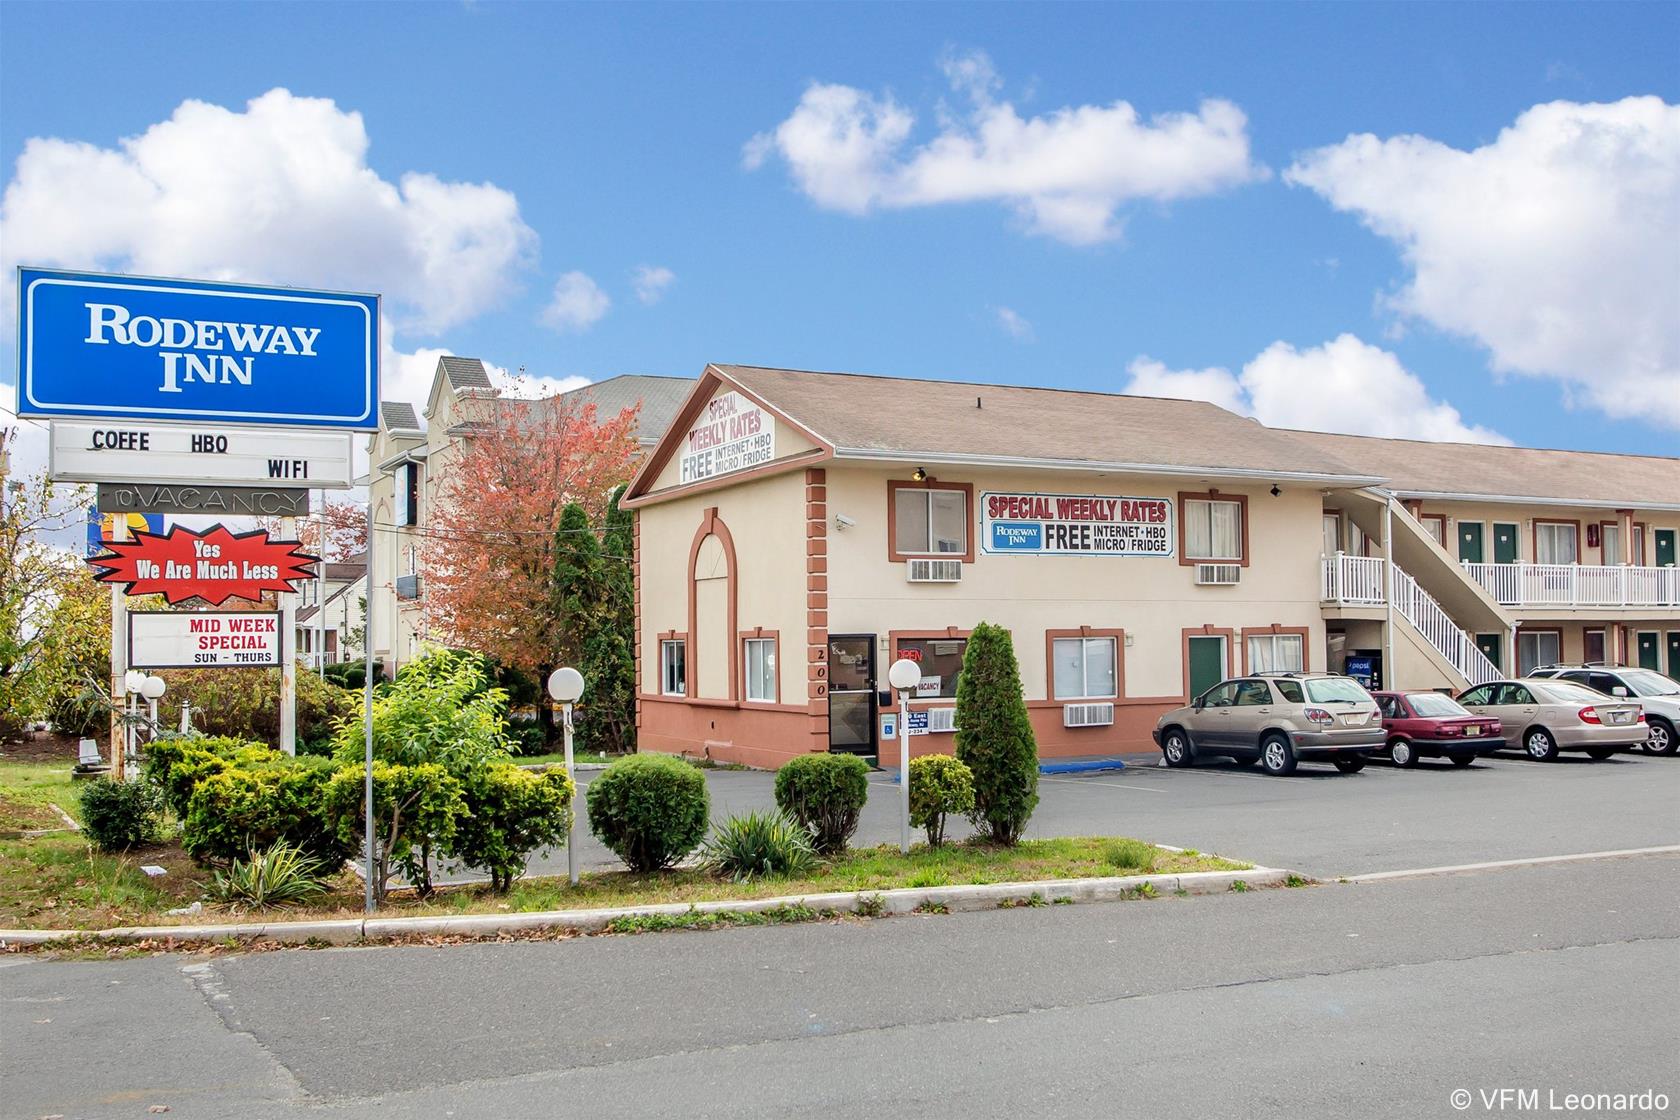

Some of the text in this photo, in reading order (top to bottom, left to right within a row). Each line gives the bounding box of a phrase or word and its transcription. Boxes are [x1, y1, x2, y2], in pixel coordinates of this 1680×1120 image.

[85, 302, 321, 356] RODEWAY
[159, 351, 254, 393] INN
[709, 394, 738, 422] SPECIAL
[689, 408, 761, 452] WEEKLY RATES
[93, 431, 228, 453] COFFE HBO
[268, 459, 308, 478] WIFI
[683, 451, 712, 482] FREE
[135, 486, 305, 513] VACANCY
[988, 496, 1166, 523] SPECIAL WEEKLY RATES
[996, 526, 1038, 537] RODEWAY
[1009, 536, 1026, 546] INN
[1045, 524, 1091, 550] FREE
[193, 540, 220, 558] Yes
[136, 560, 278, 580] We Are Much Less
[190, 619, 276, 633] MID WEEK
[199, 635, 267, 650] SPECIAL
[194, 653, 217, 663] SUN
[234, 652, 272, 662] THURS
